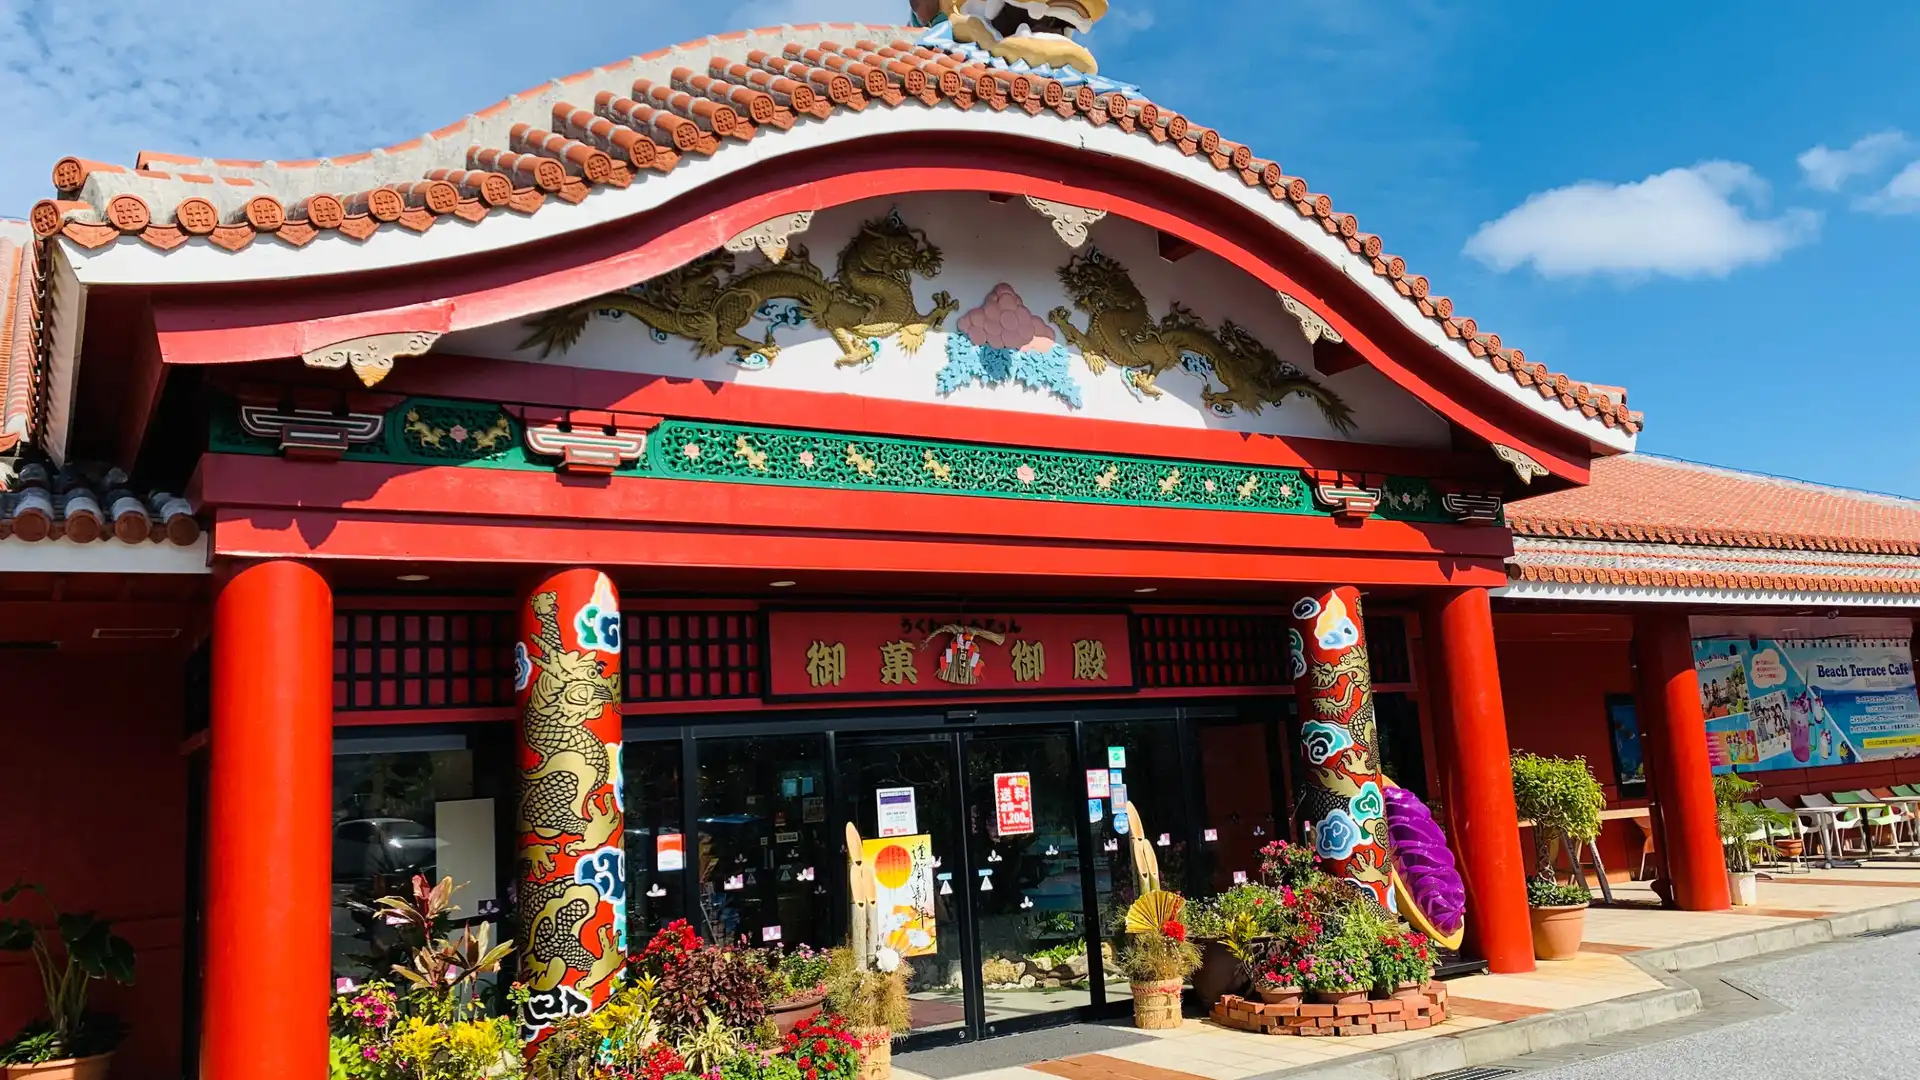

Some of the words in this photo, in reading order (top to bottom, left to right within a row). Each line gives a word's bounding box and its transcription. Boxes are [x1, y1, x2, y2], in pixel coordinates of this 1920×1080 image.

[807, 639, 1107, 687] 御菓御殿
[1817, 665, 1848, 678] Beach
[1849, 664, 1886, 677] Terrace
[1888, 662, 1909, 676] Café
